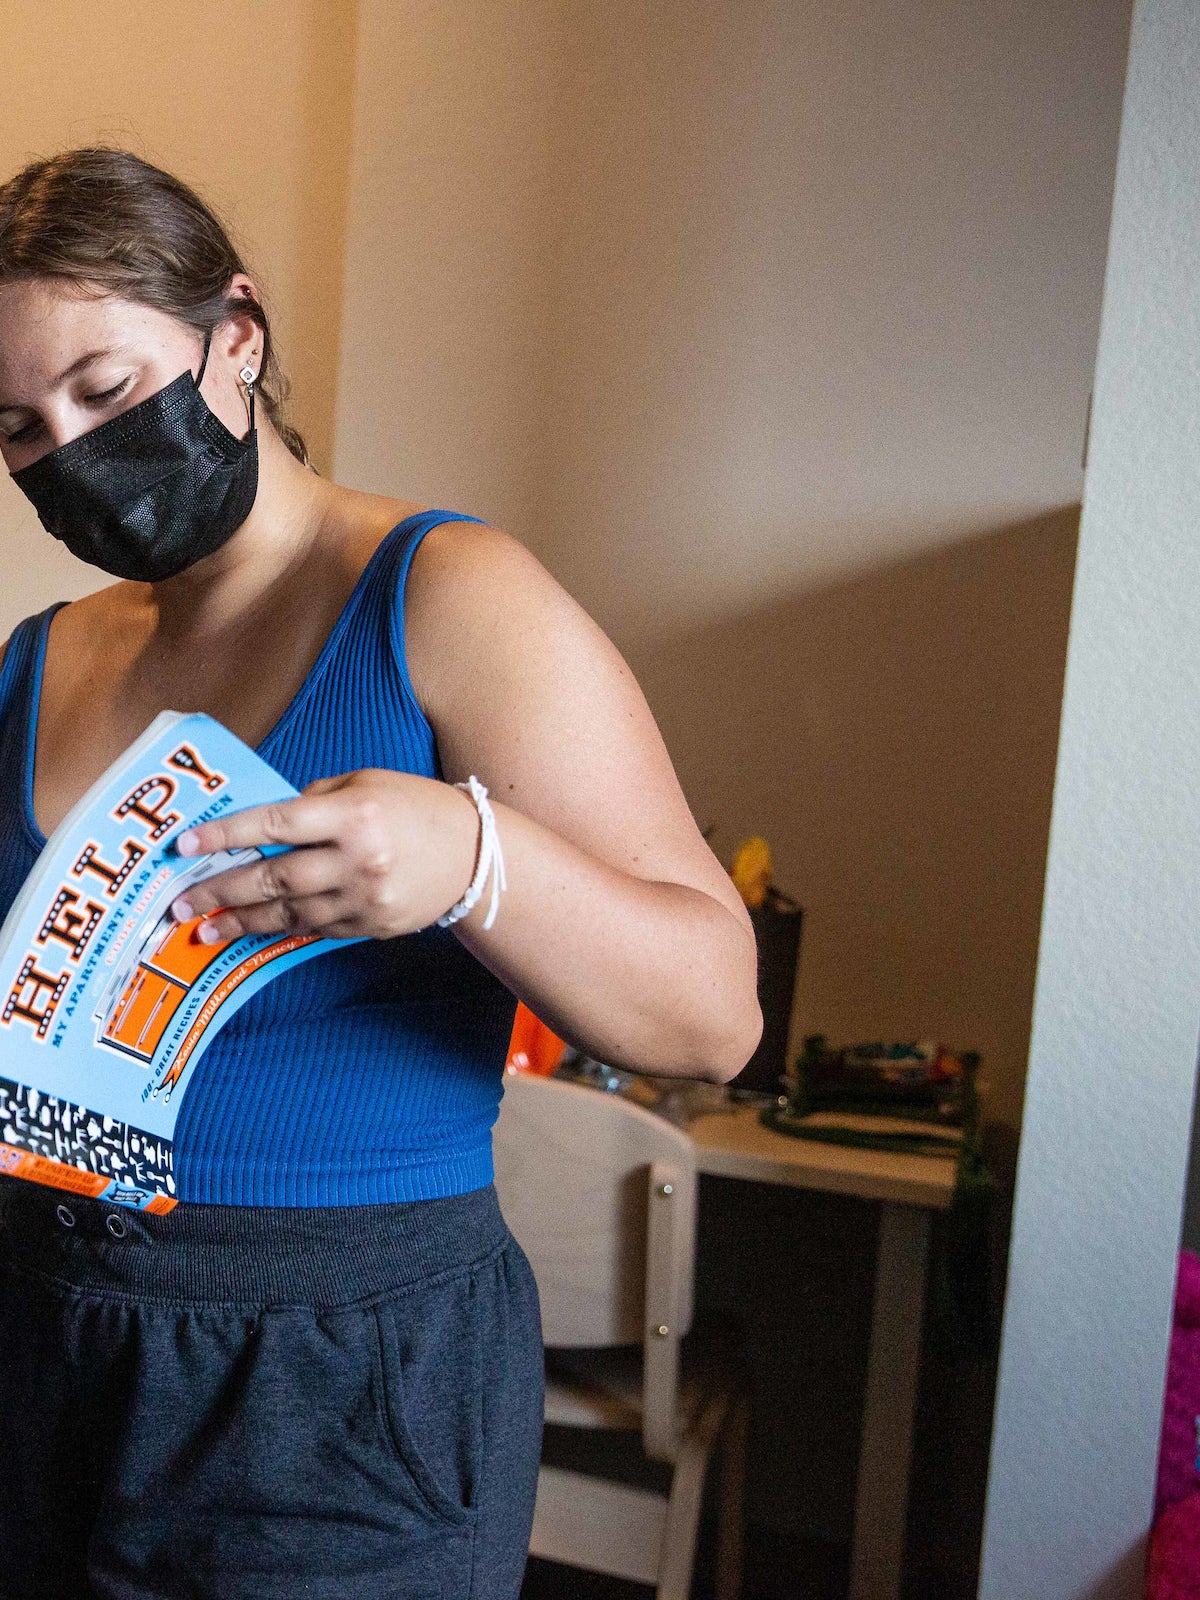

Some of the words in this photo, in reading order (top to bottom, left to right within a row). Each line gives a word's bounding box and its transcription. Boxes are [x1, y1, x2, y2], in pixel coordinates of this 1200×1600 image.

[0, 744, 226, 1041] HELP!
[52, 1023, 69, 1049] MY
[64, 908, 125, 1017] APARTMENT
[122, 869, 152, 906] HAS
[151, 856, 164, 869] A
[154, 1041, 176, 1078] GREAT
[172, 996, 201, 1042] RECIPES
[198, 967, 224, 994] WITH
[172, 1032, 200, 1072] Kevin
[196, 987, 228, 1031] Mills
[226, 967, 248, 990] and
[243, 940, 297, 968] Nancy
